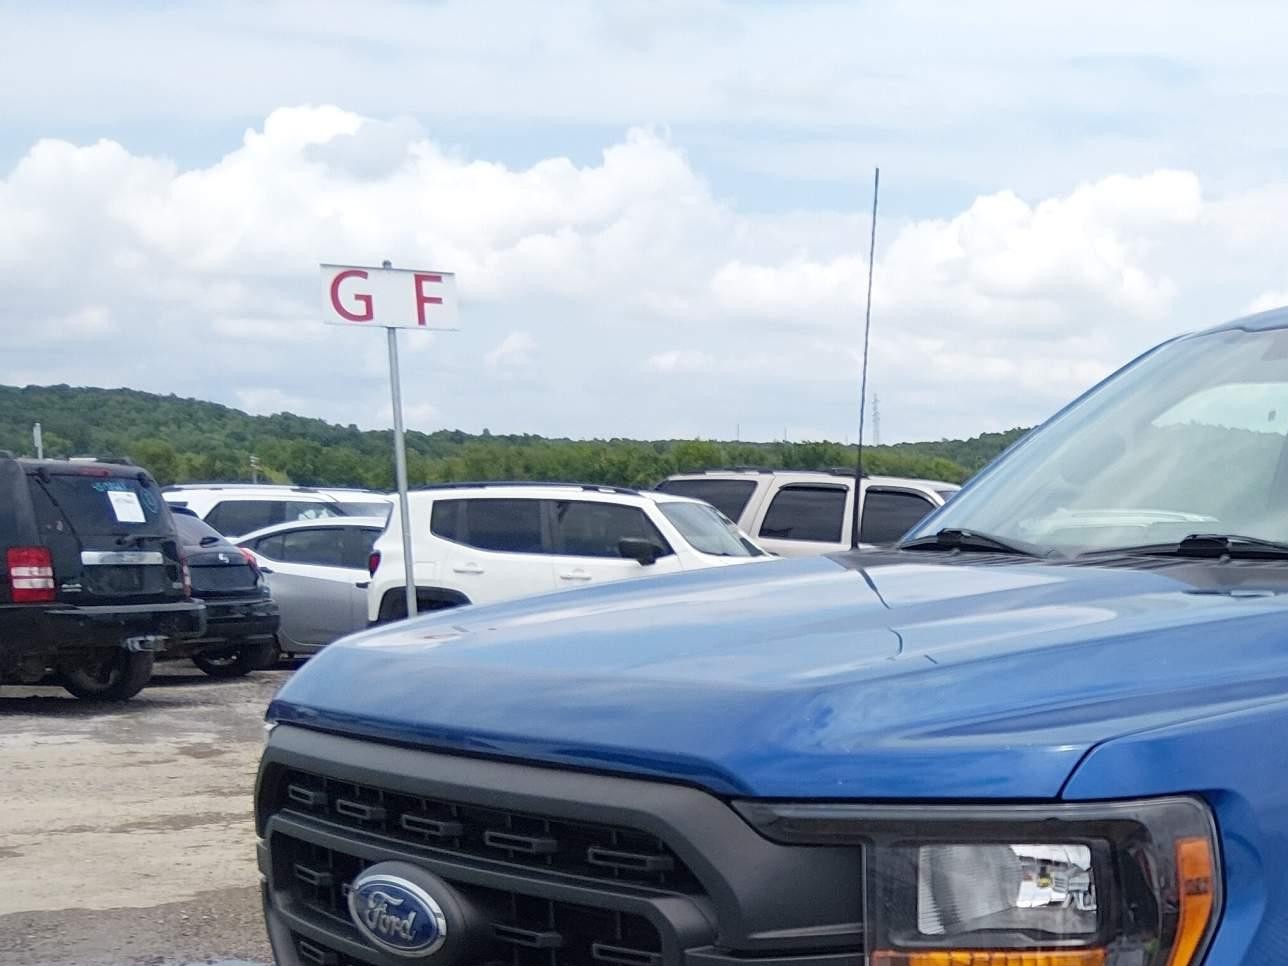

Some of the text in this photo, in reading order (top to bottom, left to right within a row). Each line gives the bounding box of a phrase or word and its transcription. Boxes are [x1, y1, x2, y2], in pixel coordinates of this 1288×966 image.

[330, 269, 443, 326] G F
[366, 891, 417, 941] Ford
